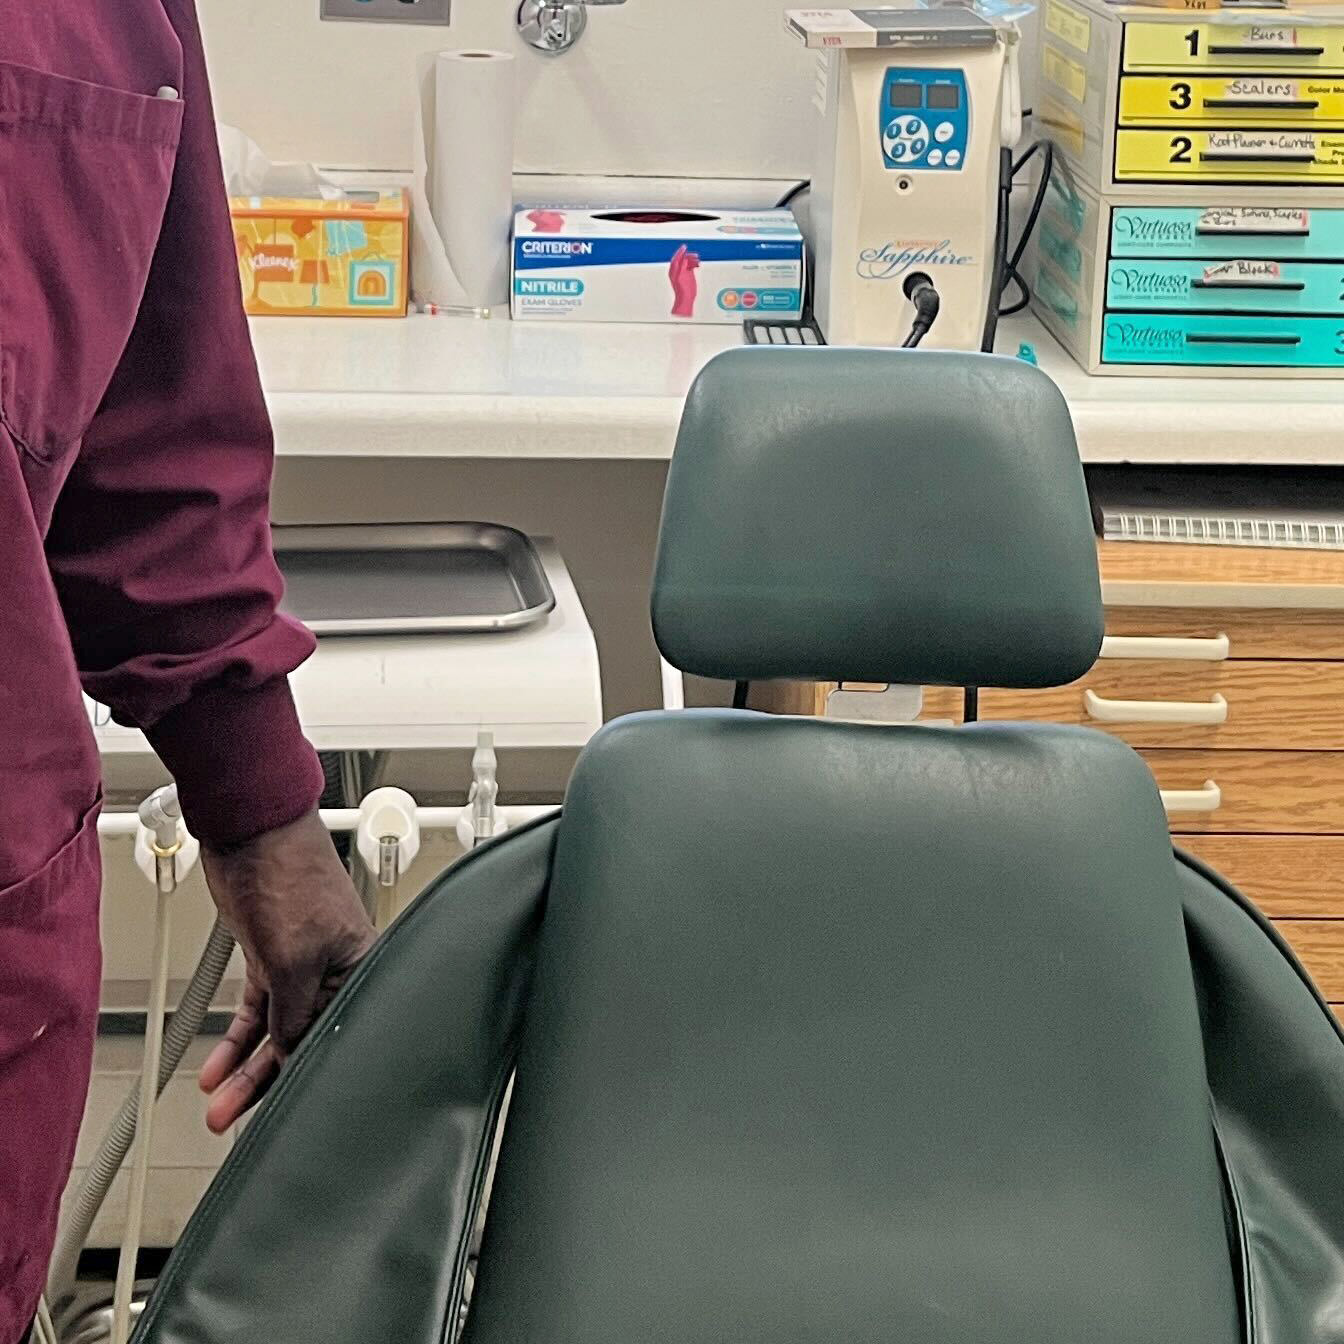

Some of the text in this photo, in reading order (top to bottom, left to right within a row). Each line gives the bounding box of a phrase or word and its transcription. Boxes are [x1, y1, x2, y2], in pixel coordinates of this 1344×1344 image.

[1184, 29, 1200, 56] 1
[1249, 26, 1285, 42] Burs
[1168, 82, 1192, 110] 3
[1231, 80, 1292, 97] Scalers
[1168, 136, 1193, 164] 2
[1114, 215, 1192, 238] Virtuoso
[521, 240, 593, 255] CRITERION
[856, 239, 973, 279] Sapphire
[249, 253, 298, 272] Kleenex
[521, 280, 579, 293] NITRILE
[1110, 268, 1188, 291] Virtuoso
[521, 298, 583, 307] EXAM GLOVES
[1106, 322, 1184, 345] Virtuoso
